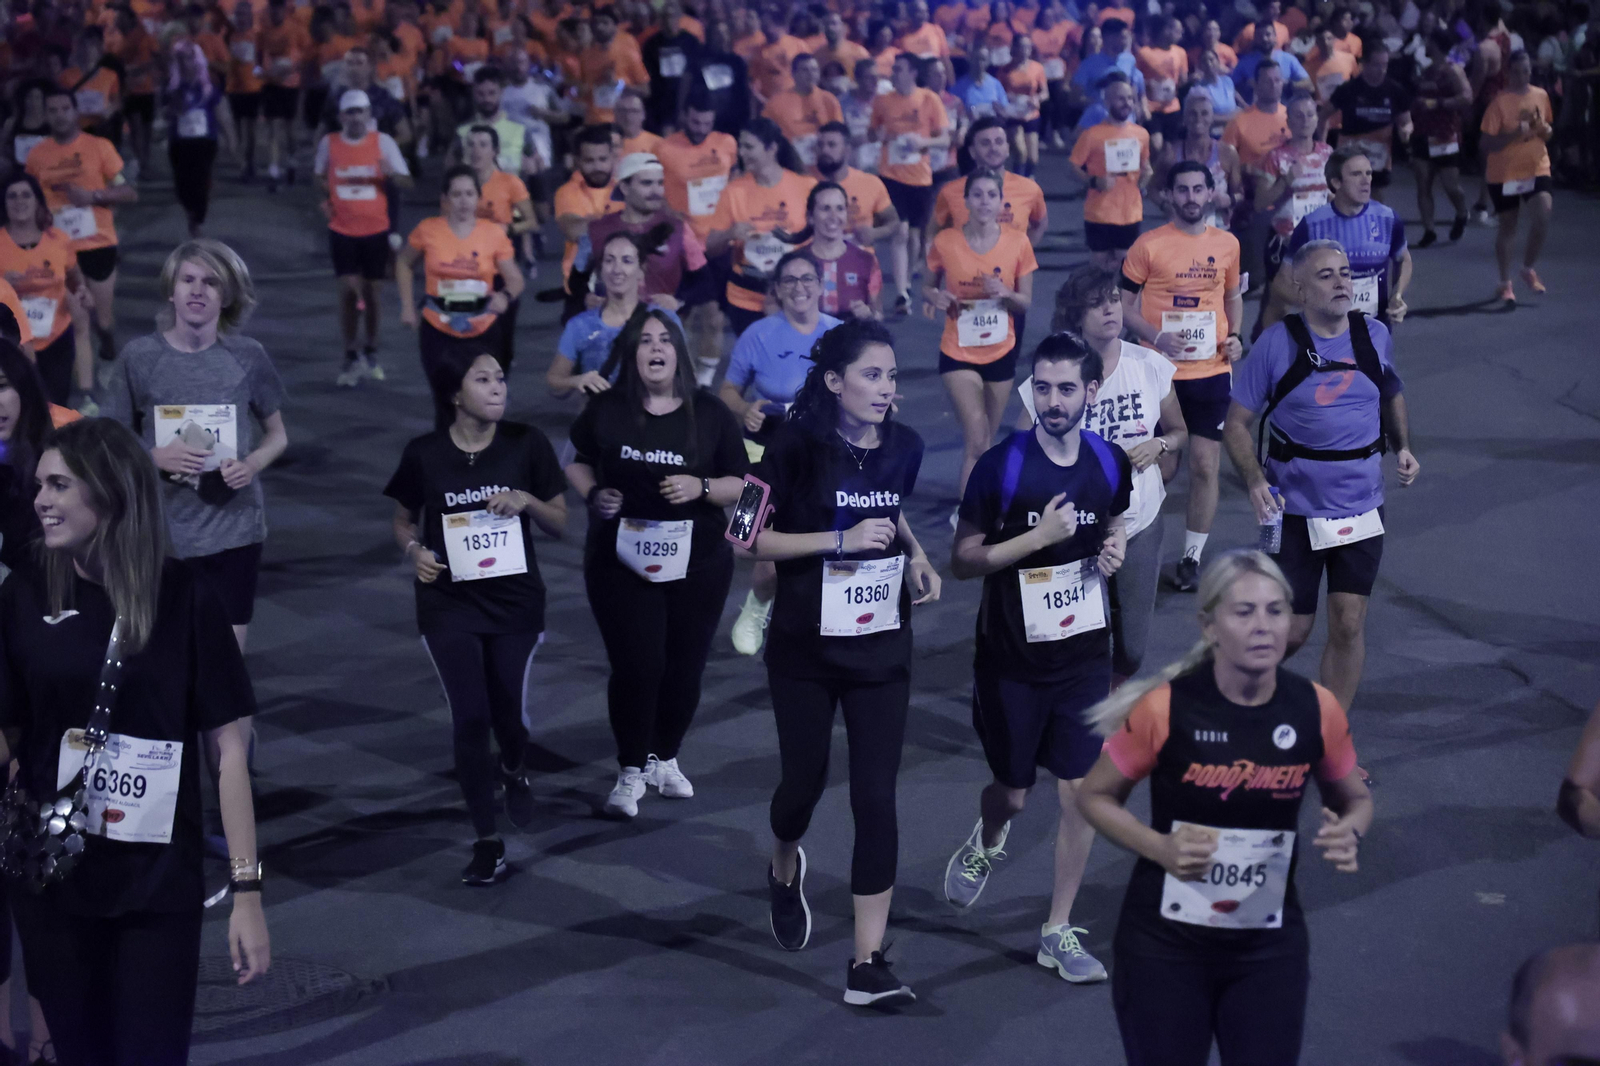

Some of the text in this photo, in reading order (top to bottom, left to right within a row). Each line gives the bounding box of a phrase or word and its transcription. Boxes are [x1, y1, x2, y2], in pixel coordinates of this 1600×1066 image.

[973, 315, 998, 327] 4844
[1085, 393, 1144, 429] FREE
[463, 531, 508, 551] 18377
[635, 541, 678, 556] 18299
[844, 583, 890, 605] 18360
[1043, 583, 1086, 610] 18341
[1200, 862, 1268, 888] 0845
